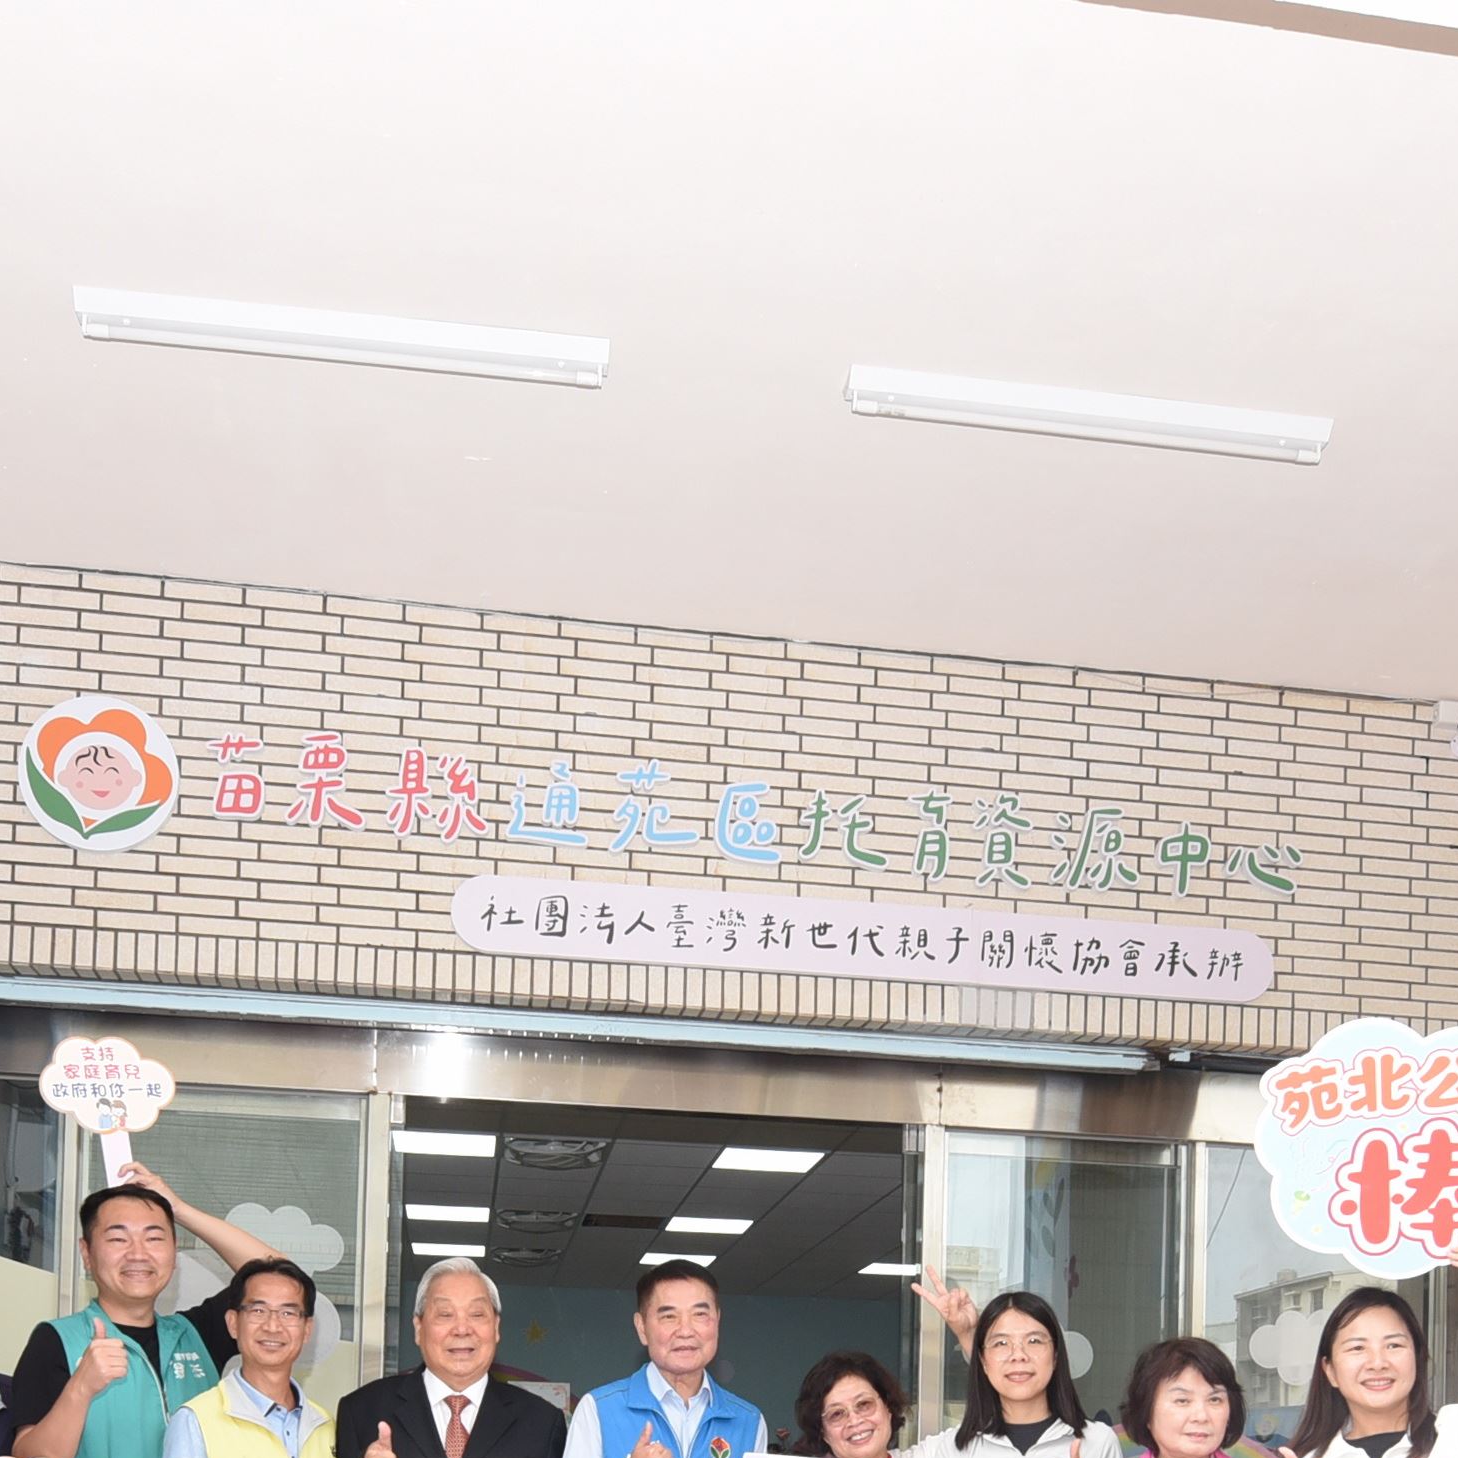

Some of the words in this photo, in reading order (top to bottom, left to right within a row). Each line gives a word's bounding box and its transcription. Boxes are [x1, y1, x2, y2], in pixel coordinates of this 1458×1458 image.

[206, 732, 1303, 897] 苗栗縣通苑區托育資源中心
[480, 894, 1245, 982] 社團法人臺灣新世代親子關懷協會承辦
[81, 1046, 114, 1061] 支持
[63, 1064, 141, 1080] 家庭育兒
[52, 1083, 163, 1098] 政府和你一起
